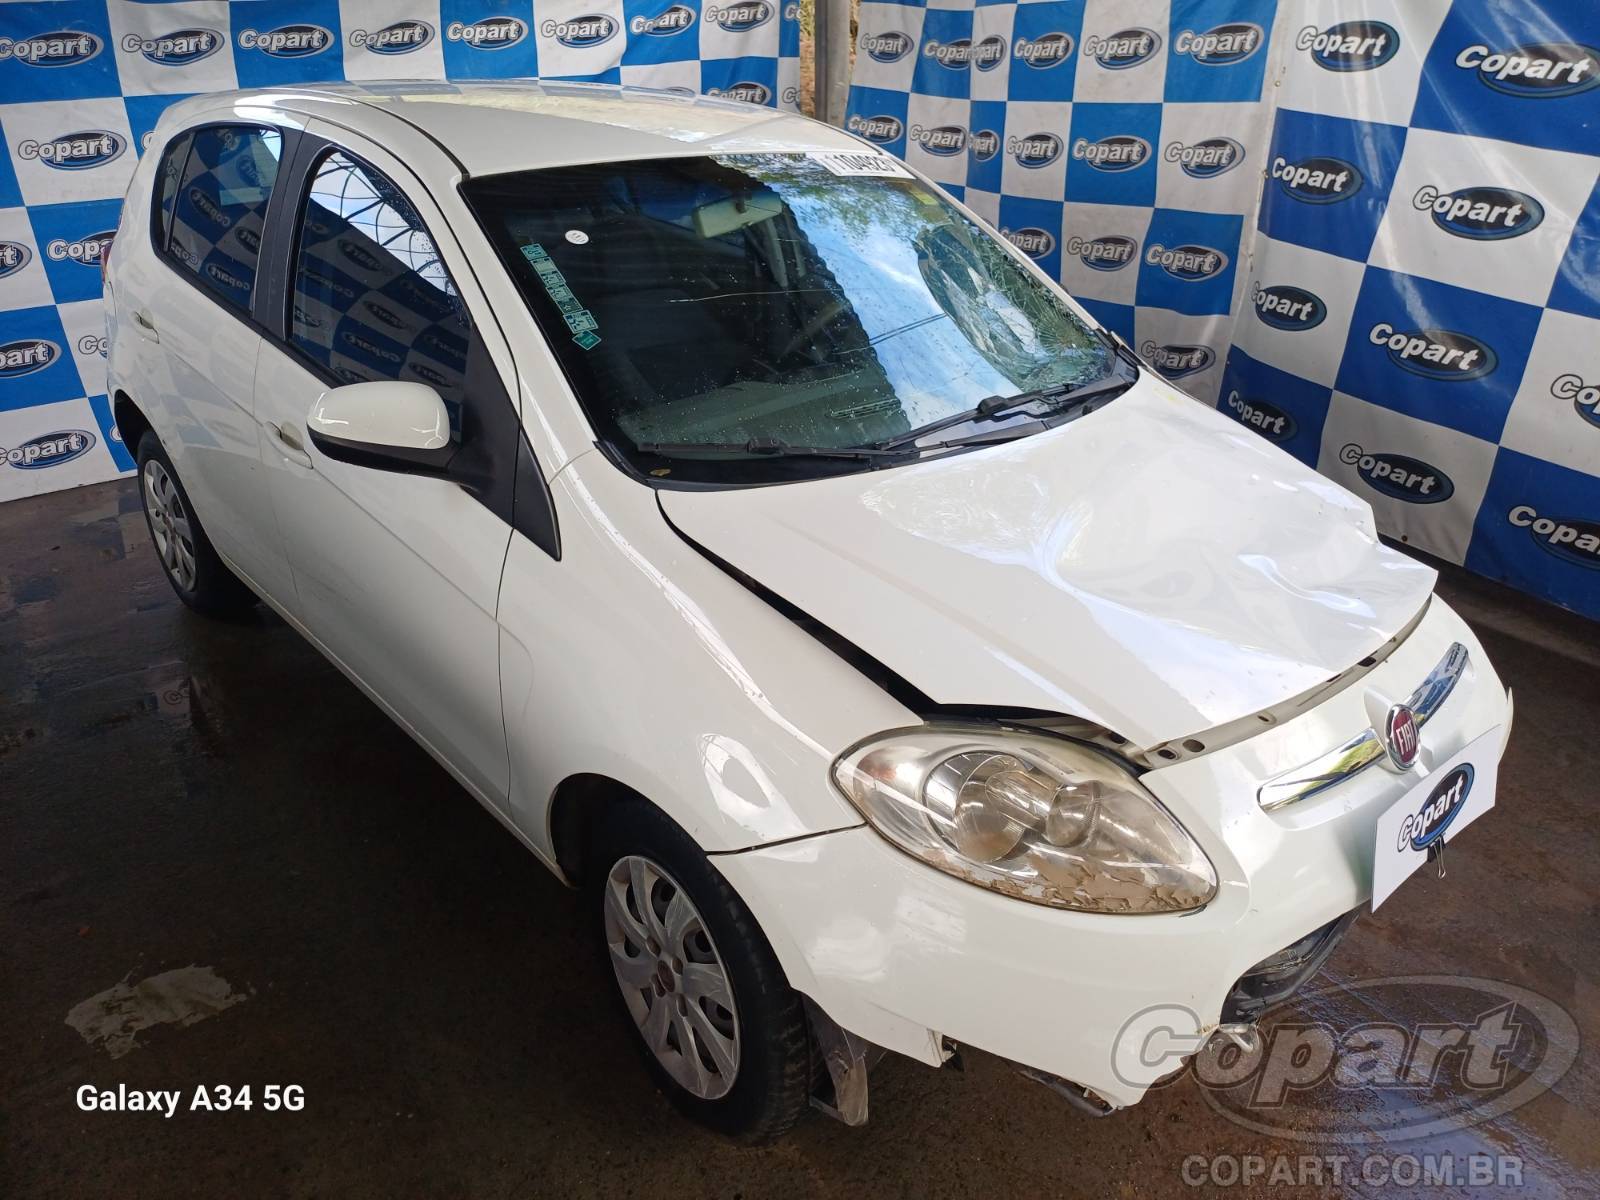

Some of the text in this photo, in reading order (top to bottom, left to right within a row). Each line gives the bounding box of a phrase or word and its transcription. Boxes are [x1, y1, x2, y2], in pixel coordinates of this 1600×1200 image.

[541, 13, 609, 40] Copart
[705, 2, 764, 25] Copart
[238, 28, 325, 51] Copart
[349, 22, 426, 46] Copart
[446, 17, 521, 43] Copart
[861, 33, 904, 54] Copart
[1296, 26, 1387, 57] Copart
[121, 32, 213, 59] Copart
[1014, 37, 1068, 61] Copart
[1083, 34, 1150, 60] Copart
[1174, 29, 1258, 60] Copart
[1456, 46, 1591, 83] Copart
[847, 116, 899, 137] Copart
[910, 124, 963, 148] Copart
[18, 134, 112, 164] Copart
[1007, 135, 1059, 160] Copart
[1072, 138, 1141, 162] Copart
[1164, 141, 1233, 167] Copart
[1271, 157, 1350, 192] Copart
[1413, 185, 1523, 227] Copart
[47, 239, 112, 264] Cop
[1067, 236, 1132, 263] Copart
[1146, 243, 1218, 275] Copart
[1369, 322, 1480, 371] Copart
[1228, 390, 1286, 435] Copart
[1340, 443, 1437, 496] Copart
[1508, 504, 1600, 553] Copa
[1395, 719, 1418, 756] FIAT
[1397, 772, 1464, 853] Copart
